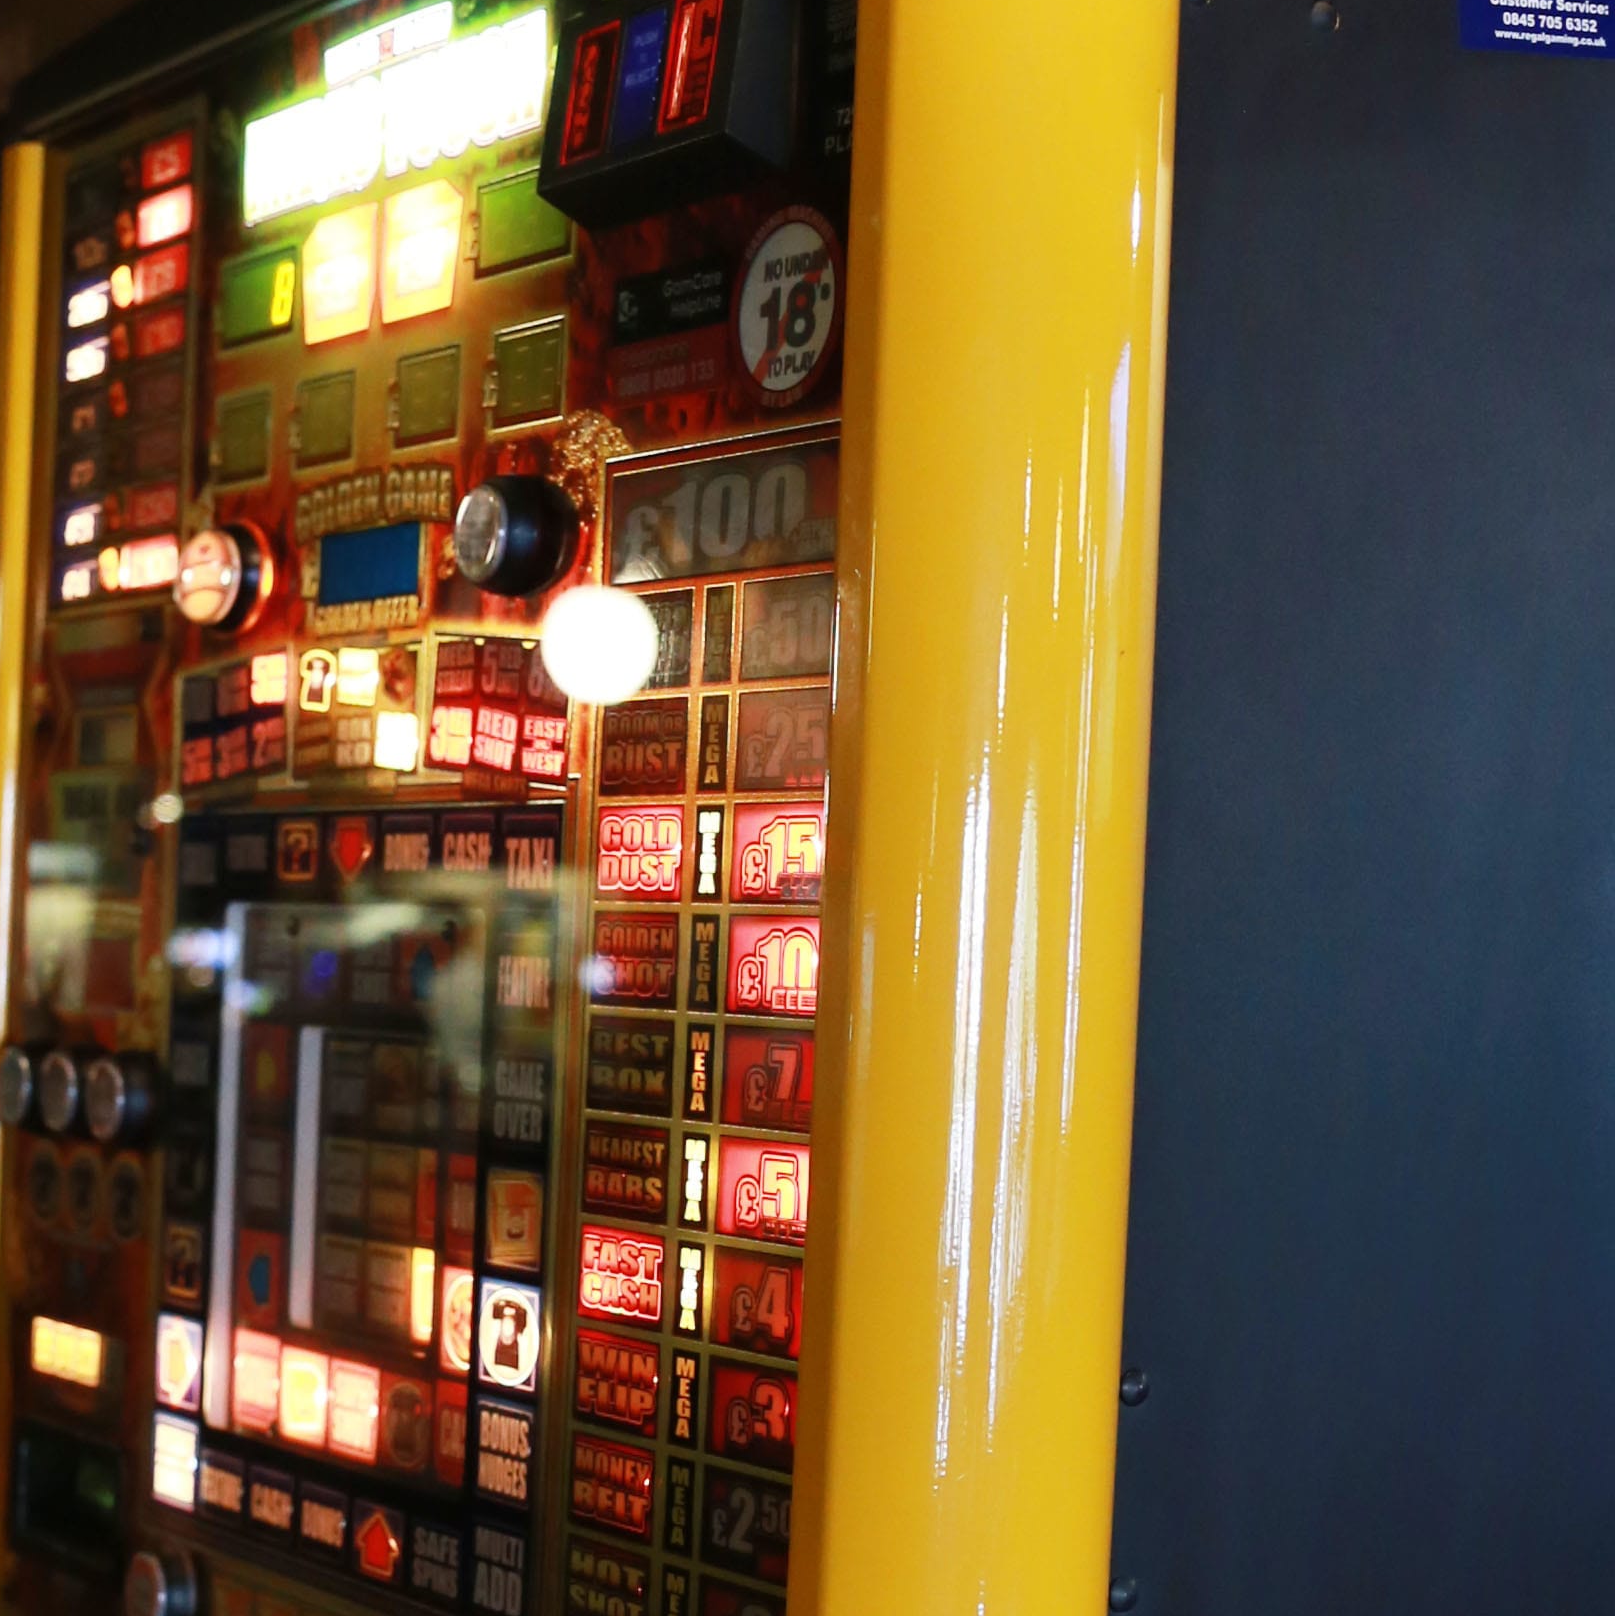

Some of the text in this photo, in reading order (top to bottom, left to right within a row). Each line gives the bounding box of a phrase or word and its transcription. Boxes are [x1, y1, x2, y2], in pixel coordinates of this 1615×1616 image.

[1495, 29, 1607, 48] www.regalgaming.co.uk
[1503, 12, 1598, 33] 0845 705 6352
[764, 259, 784, 282] NO
[767, 350, 816, 379] TO PLAY
[624, 461, 808, 564] £100
[476, 706, 518, 742] RED
[524, 716, 567, 743] EAST
[704, 704, 726, 784] MEGA
[745, 706, 826, 779] £25
[473, 735, 516, 772] SHOT
[522, 748, 565, 776] WEST
[604, 739, 682, 779] BUST
[441, 831, 492, 871] CASH
[600, 817, 680, 851] GOLD
[743, 816, 822, 894] £15
[504, 837, 556, 890] TAXI
[598, 853, 679, 888] DUST
[597, 922, 675, 957] GOLDEN
[695, 921, 716, 1002] MEGA
[596, 957, 674, 997] SHOT
[739, 931, 818, 1006] £10
[591, 1030, 669, 1059] BEST
[495, 1057, 545, 1100] GAME
[590, 1063, 666, 1096] BOX
[689, 1031, 711, 1112] MEGA
[745, 1045, 801, 1112] £7
[493, 1100, 544, 1143] OVER
[589, 1135, 666, 1169] NEAREST
[587, 1170, 663, 1210] BARS
[736, 1152, 799, 1229] £5
[583, 1235, 664, 1281] FAST
[581, 1272, 661, 1319] CASH
[734, 1267, 792, 1340] £4
[579, 1341, 657, 1386] WIN
[577, 1377, 656, 1424] FLIP
[675, 1356, 696, 1439] MEGA
[728, 1379, 790, 1449] £3
[478, 1409, 532, 1459] BONUS
[575, 1445, 652, 1489] MONEY
[573, 1480, 649, 1525] BELT
[671, 1464, 691, 1546] MEGA
[474, 1524, 525, 1571] MULTI
[570, 1547, 646, 1593] HOT
